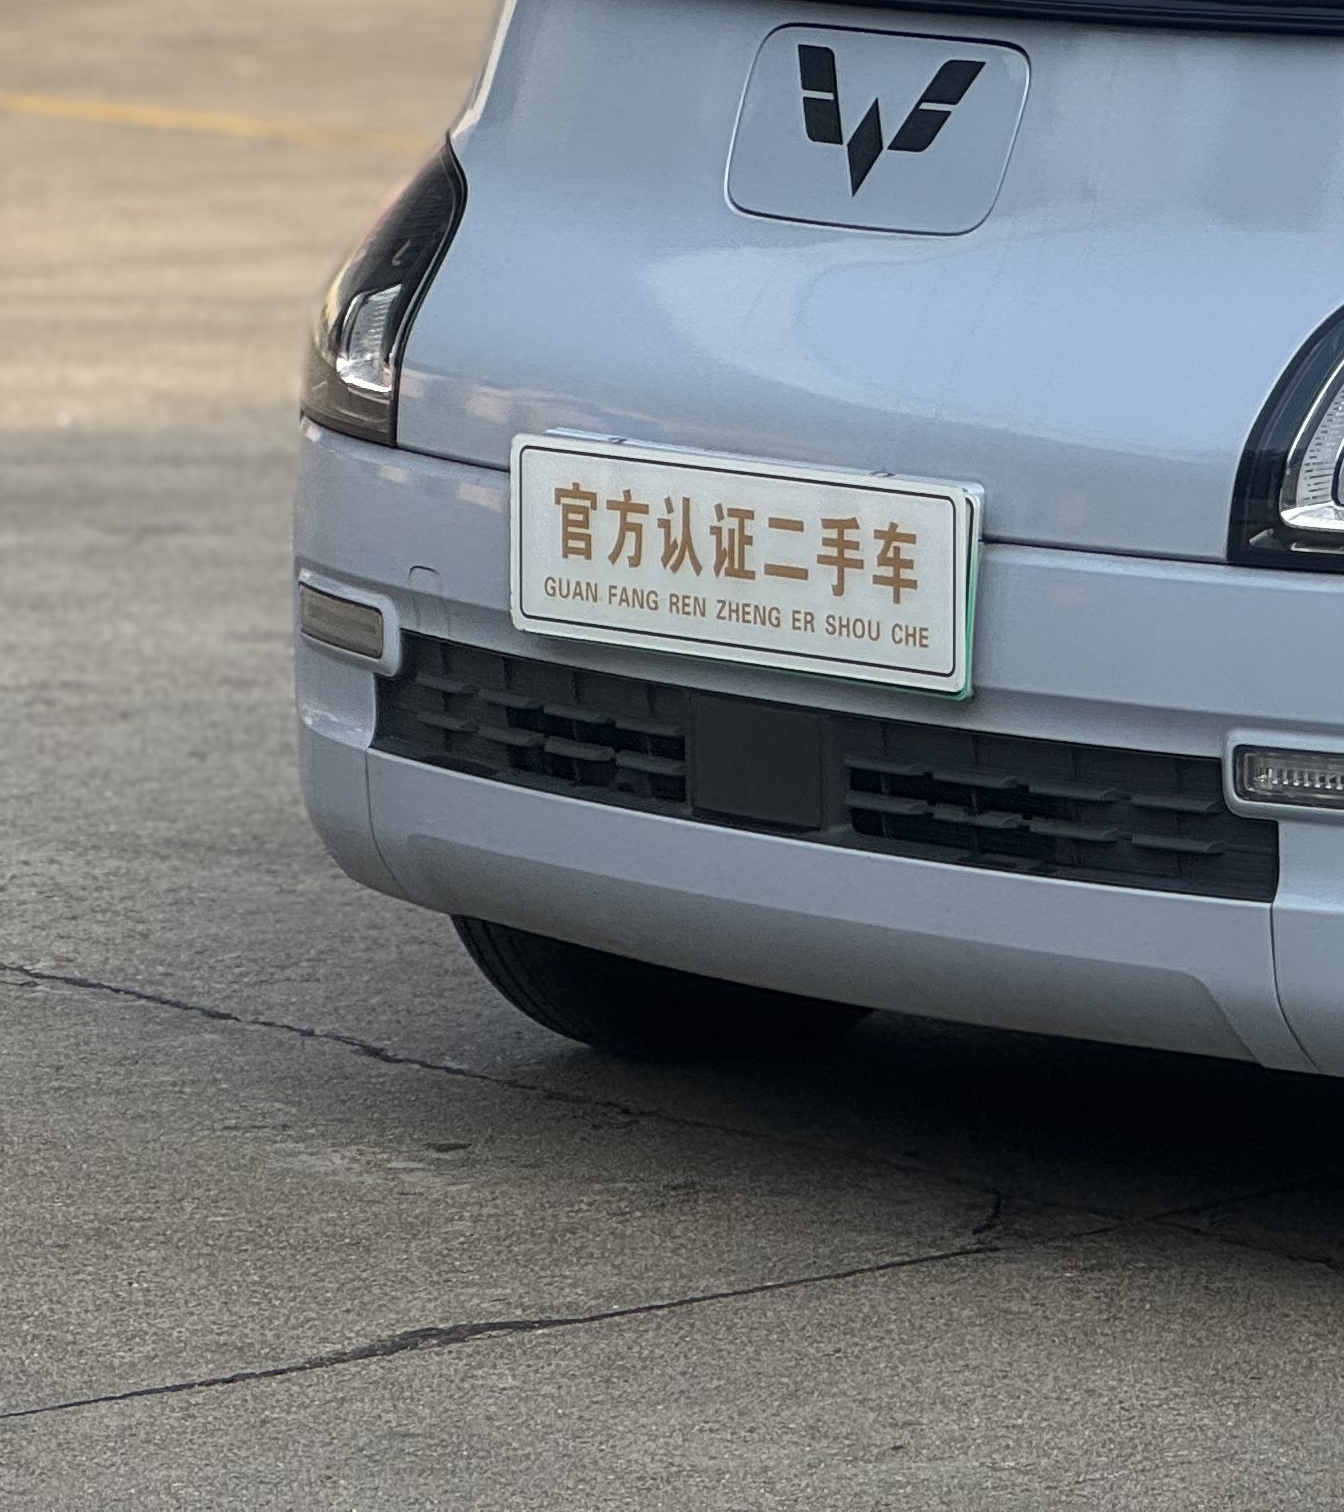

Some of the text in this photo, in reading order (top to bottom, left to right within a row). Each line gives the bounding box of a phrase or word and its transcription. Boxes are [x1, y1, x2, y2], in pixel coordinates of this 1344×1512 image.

[553, 482, 919, 605] 官方认证二手车
[543, 576, 930, 650] GUAN FANG REN ZHENG ER SHOU CHE
